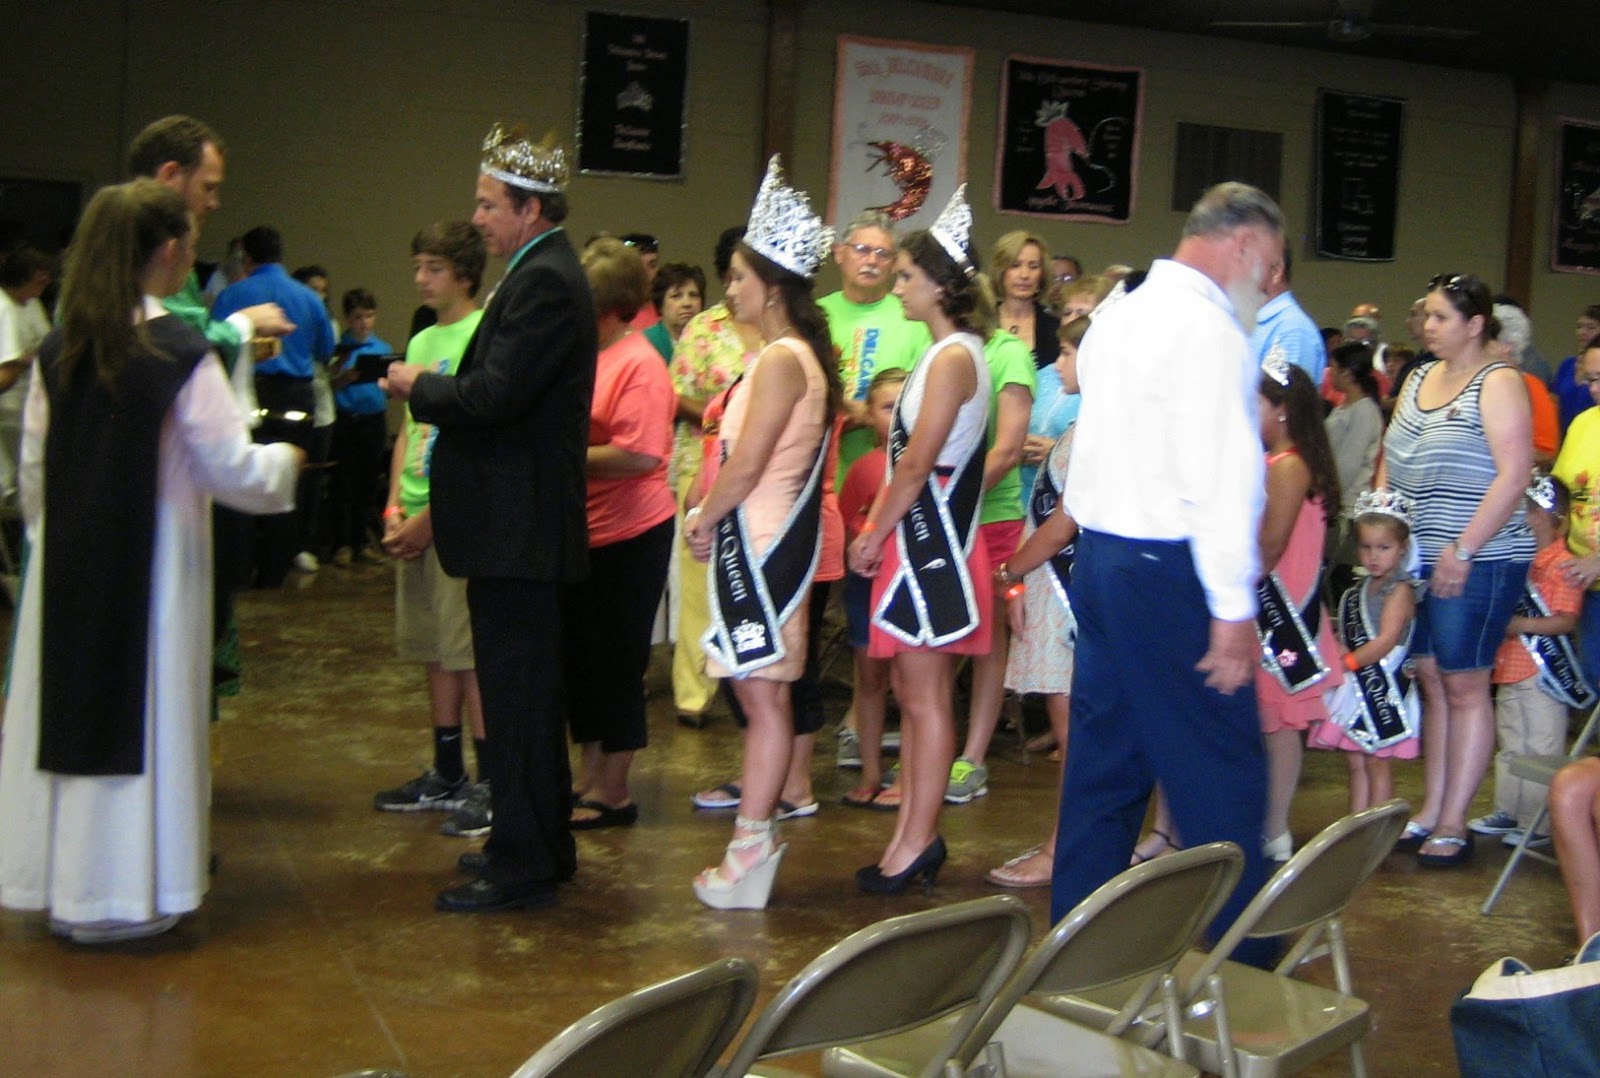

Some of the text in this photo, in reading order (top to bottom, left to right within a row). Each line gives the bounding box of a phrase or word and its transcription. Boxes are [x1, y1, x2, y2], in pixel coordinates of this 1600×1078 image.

[909, 501, 931, 542] ueen
[719, 534, 749, 603] Queen
[1364, 674, 1394, 726] Queen
